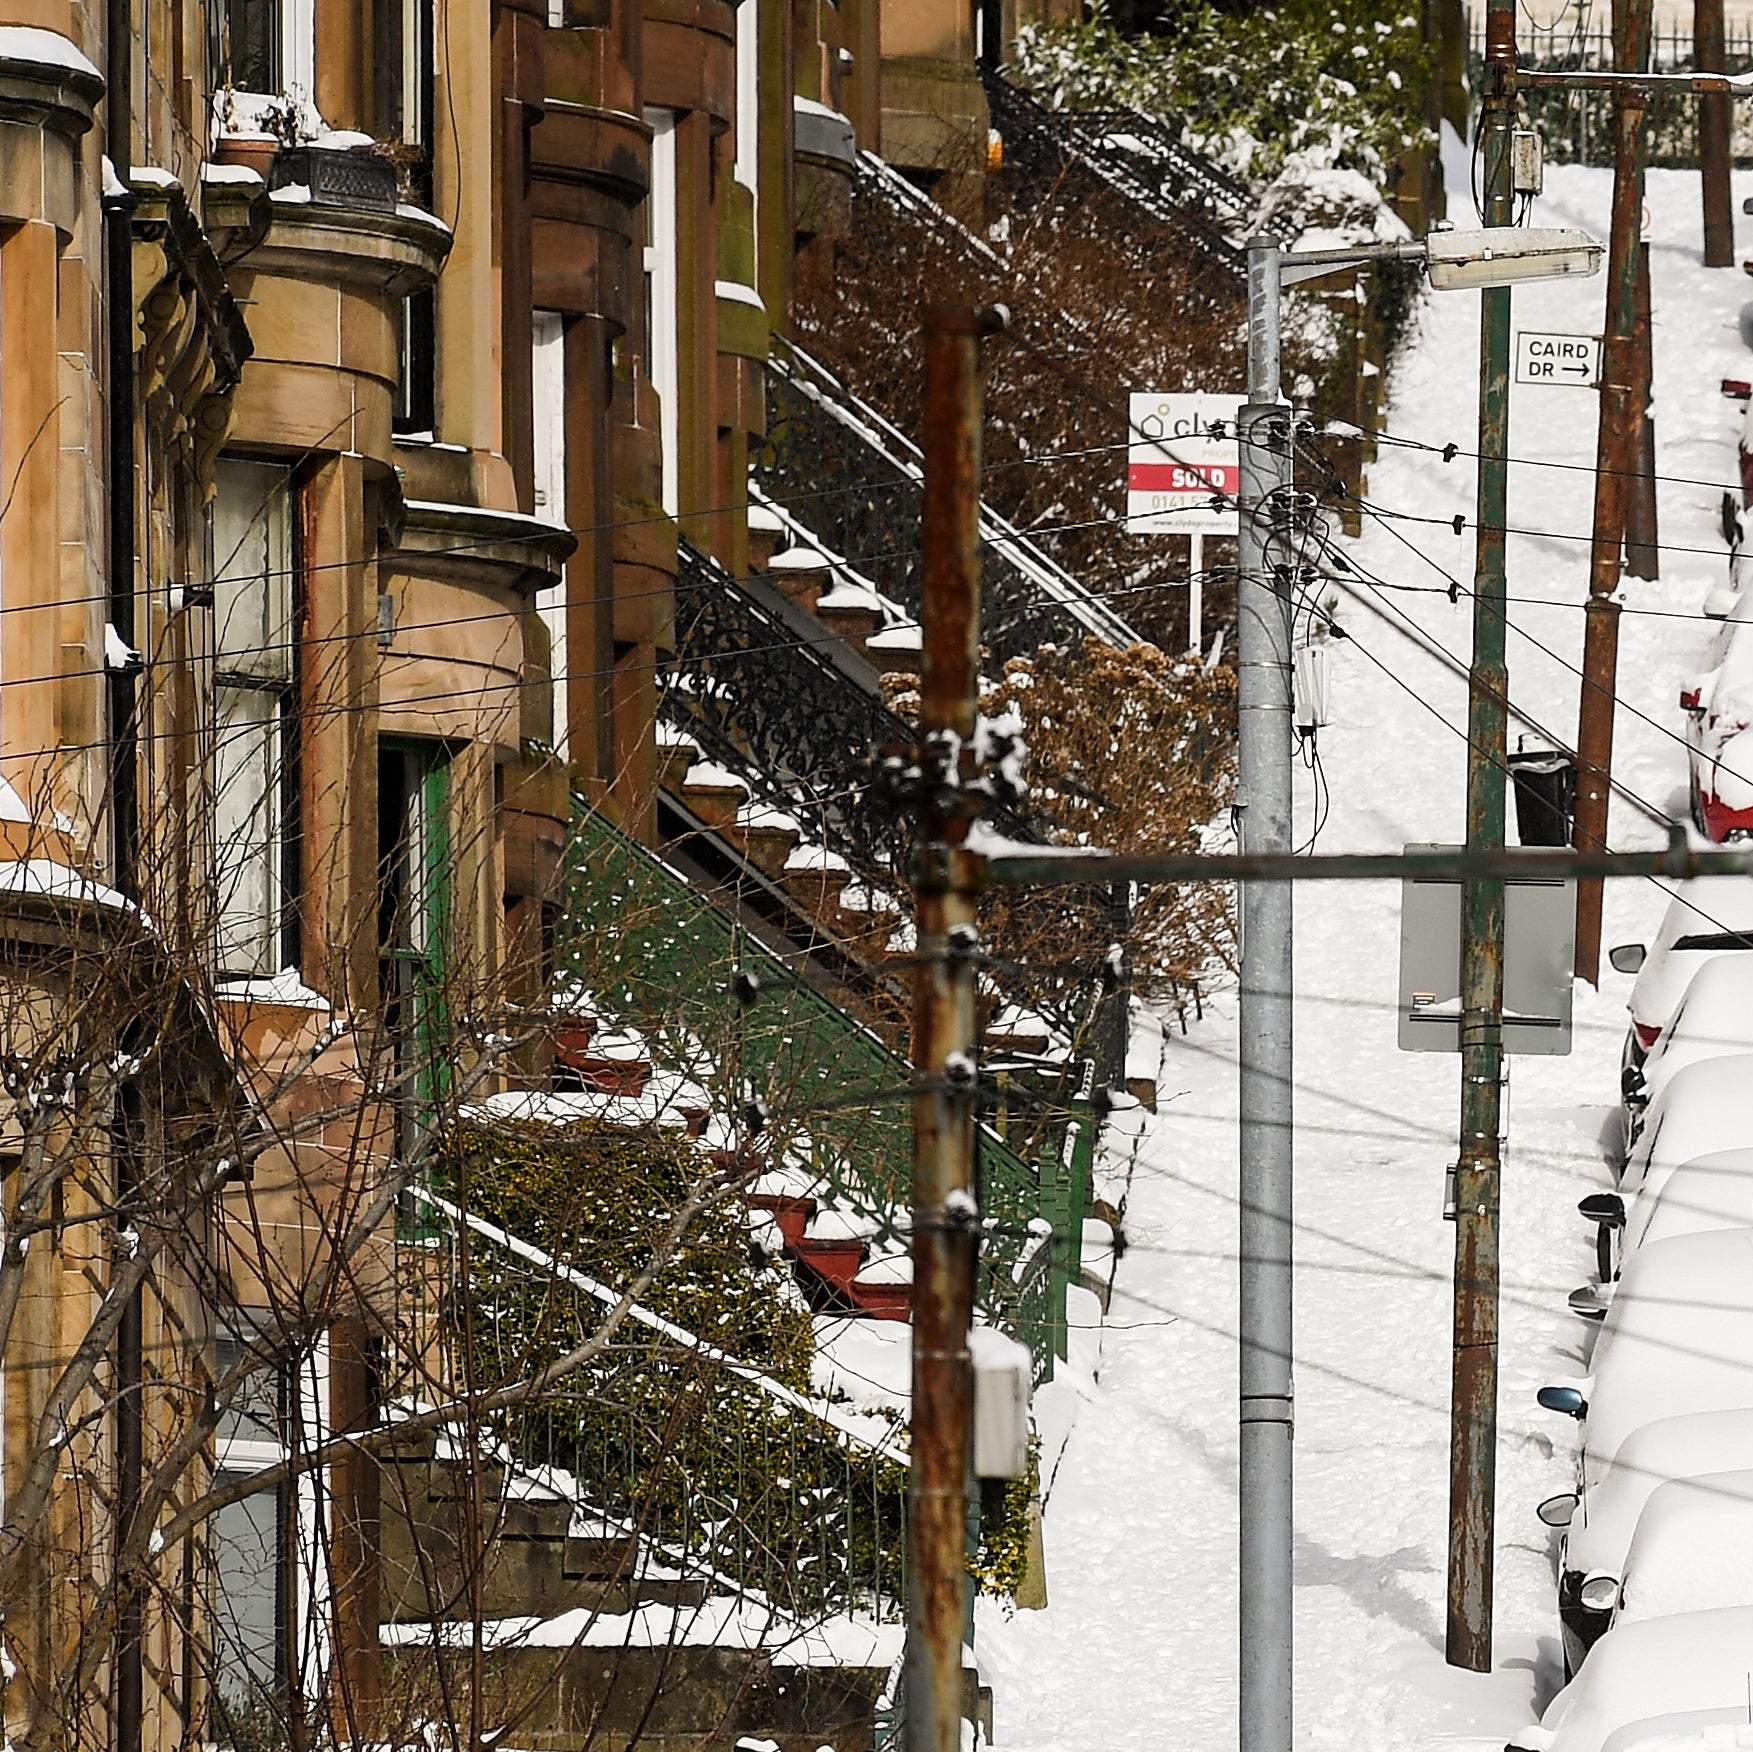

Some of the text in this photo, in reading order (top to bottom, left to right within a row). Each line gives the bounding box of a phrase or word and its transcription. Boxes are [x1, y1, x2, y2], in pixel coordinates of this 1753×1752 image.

[1529, 340, 1589, 359] CAIRD
[1528, 361, 1554, 377] DR
[1171, 467, 1226, 489] SOLD
